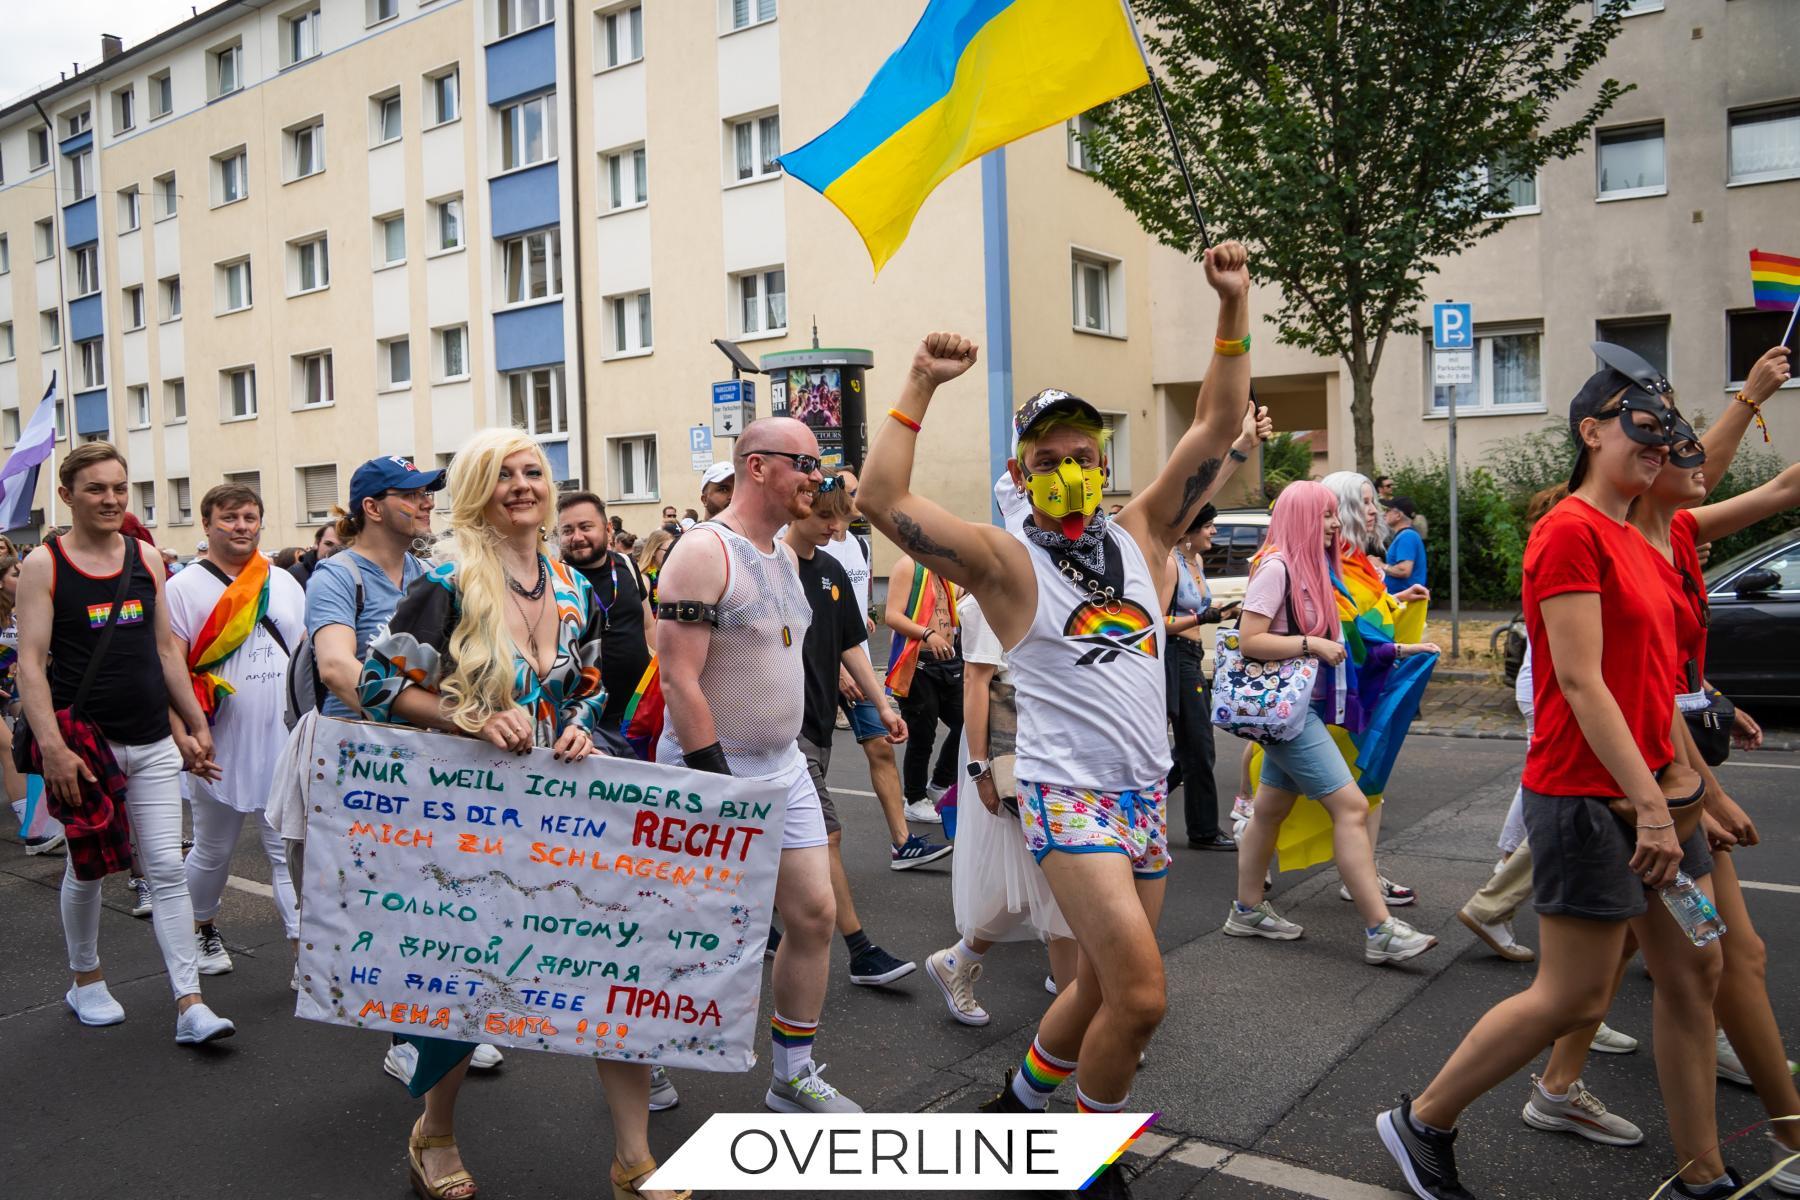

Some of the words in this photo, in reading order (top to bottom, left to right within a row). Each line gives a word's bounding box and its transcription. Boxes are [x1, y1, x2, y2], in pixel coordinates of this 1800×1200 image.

[1442, 308, 1463, 343] P
[692, 429, 705, 449] P
[352, 759, 407, 785] NUR
[429, 766, 504, 792] WEIL
[525, 773, 577, 798] ICH
[588, 779, 703, 814] ANDERS
[718, 799, 772, 820] BIN
[343, 790, 410, 815] GIBT
[423, 800, 456, 822] ES
[466, 805, 523, 829] DIR
[540, 814, 607, 838] KEIN
[632, 809, 764, 862] RECHT
[348, 820, 433, 849] MICH
[457, 833, 504, 855] ZU
[358, 889, 478, 922] ТОЛЬКО
[523, 914, 644, 948] ПОТОМУ,
[668, 929, 720, 951] ЧТО
[351, 931, 374, 952] Я
[350, 966, 382, 985] НЕ
[404, 973, 484, 997] ДАЁТ
[520, 989, 586, 1012] ТЕБЕ
[606, 984, 723, 1027] ПРАВА
[359, 999, 450, 1031] МЕНЯ
[485, 1012, 559, 1038] БИТЬ
